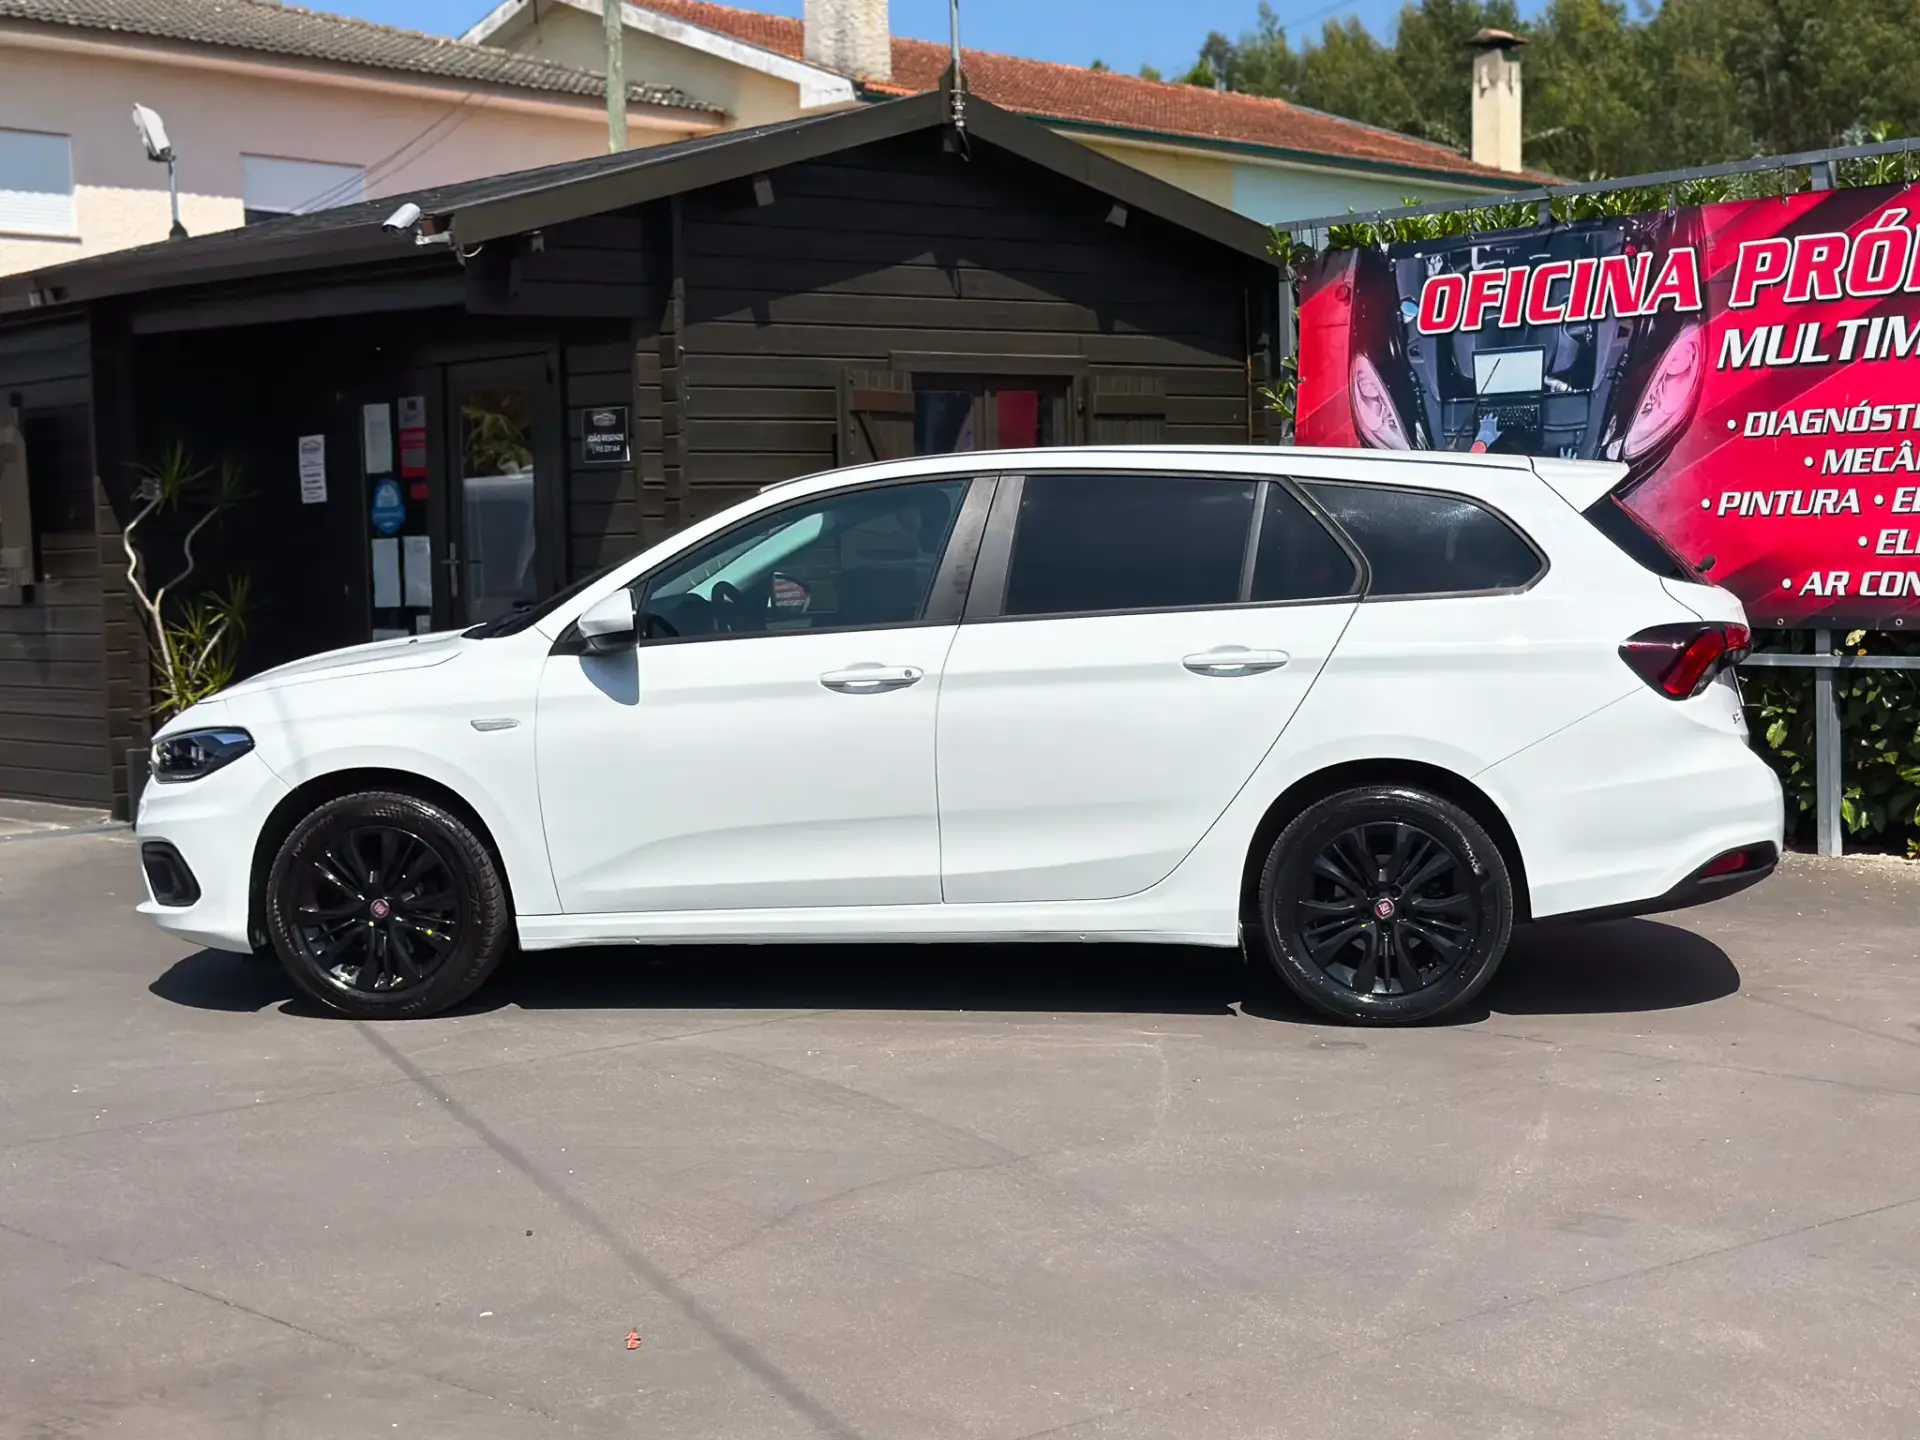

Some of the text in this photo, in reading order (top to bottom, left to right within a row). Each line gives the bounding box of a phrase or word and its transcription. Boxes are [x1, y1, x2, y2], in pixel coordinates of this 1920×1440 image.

[1417, 207, 1920, 335] OFICINA PRÓ
[1717, 315, 1920, 370] MULTIM
[1821, 440, 1920, 475] MECÂ
[1717, 488, 1860, 516] PINTURA
[1875, 528, 1920, 555] EL
[1799, 571, 1850, 597] AR
